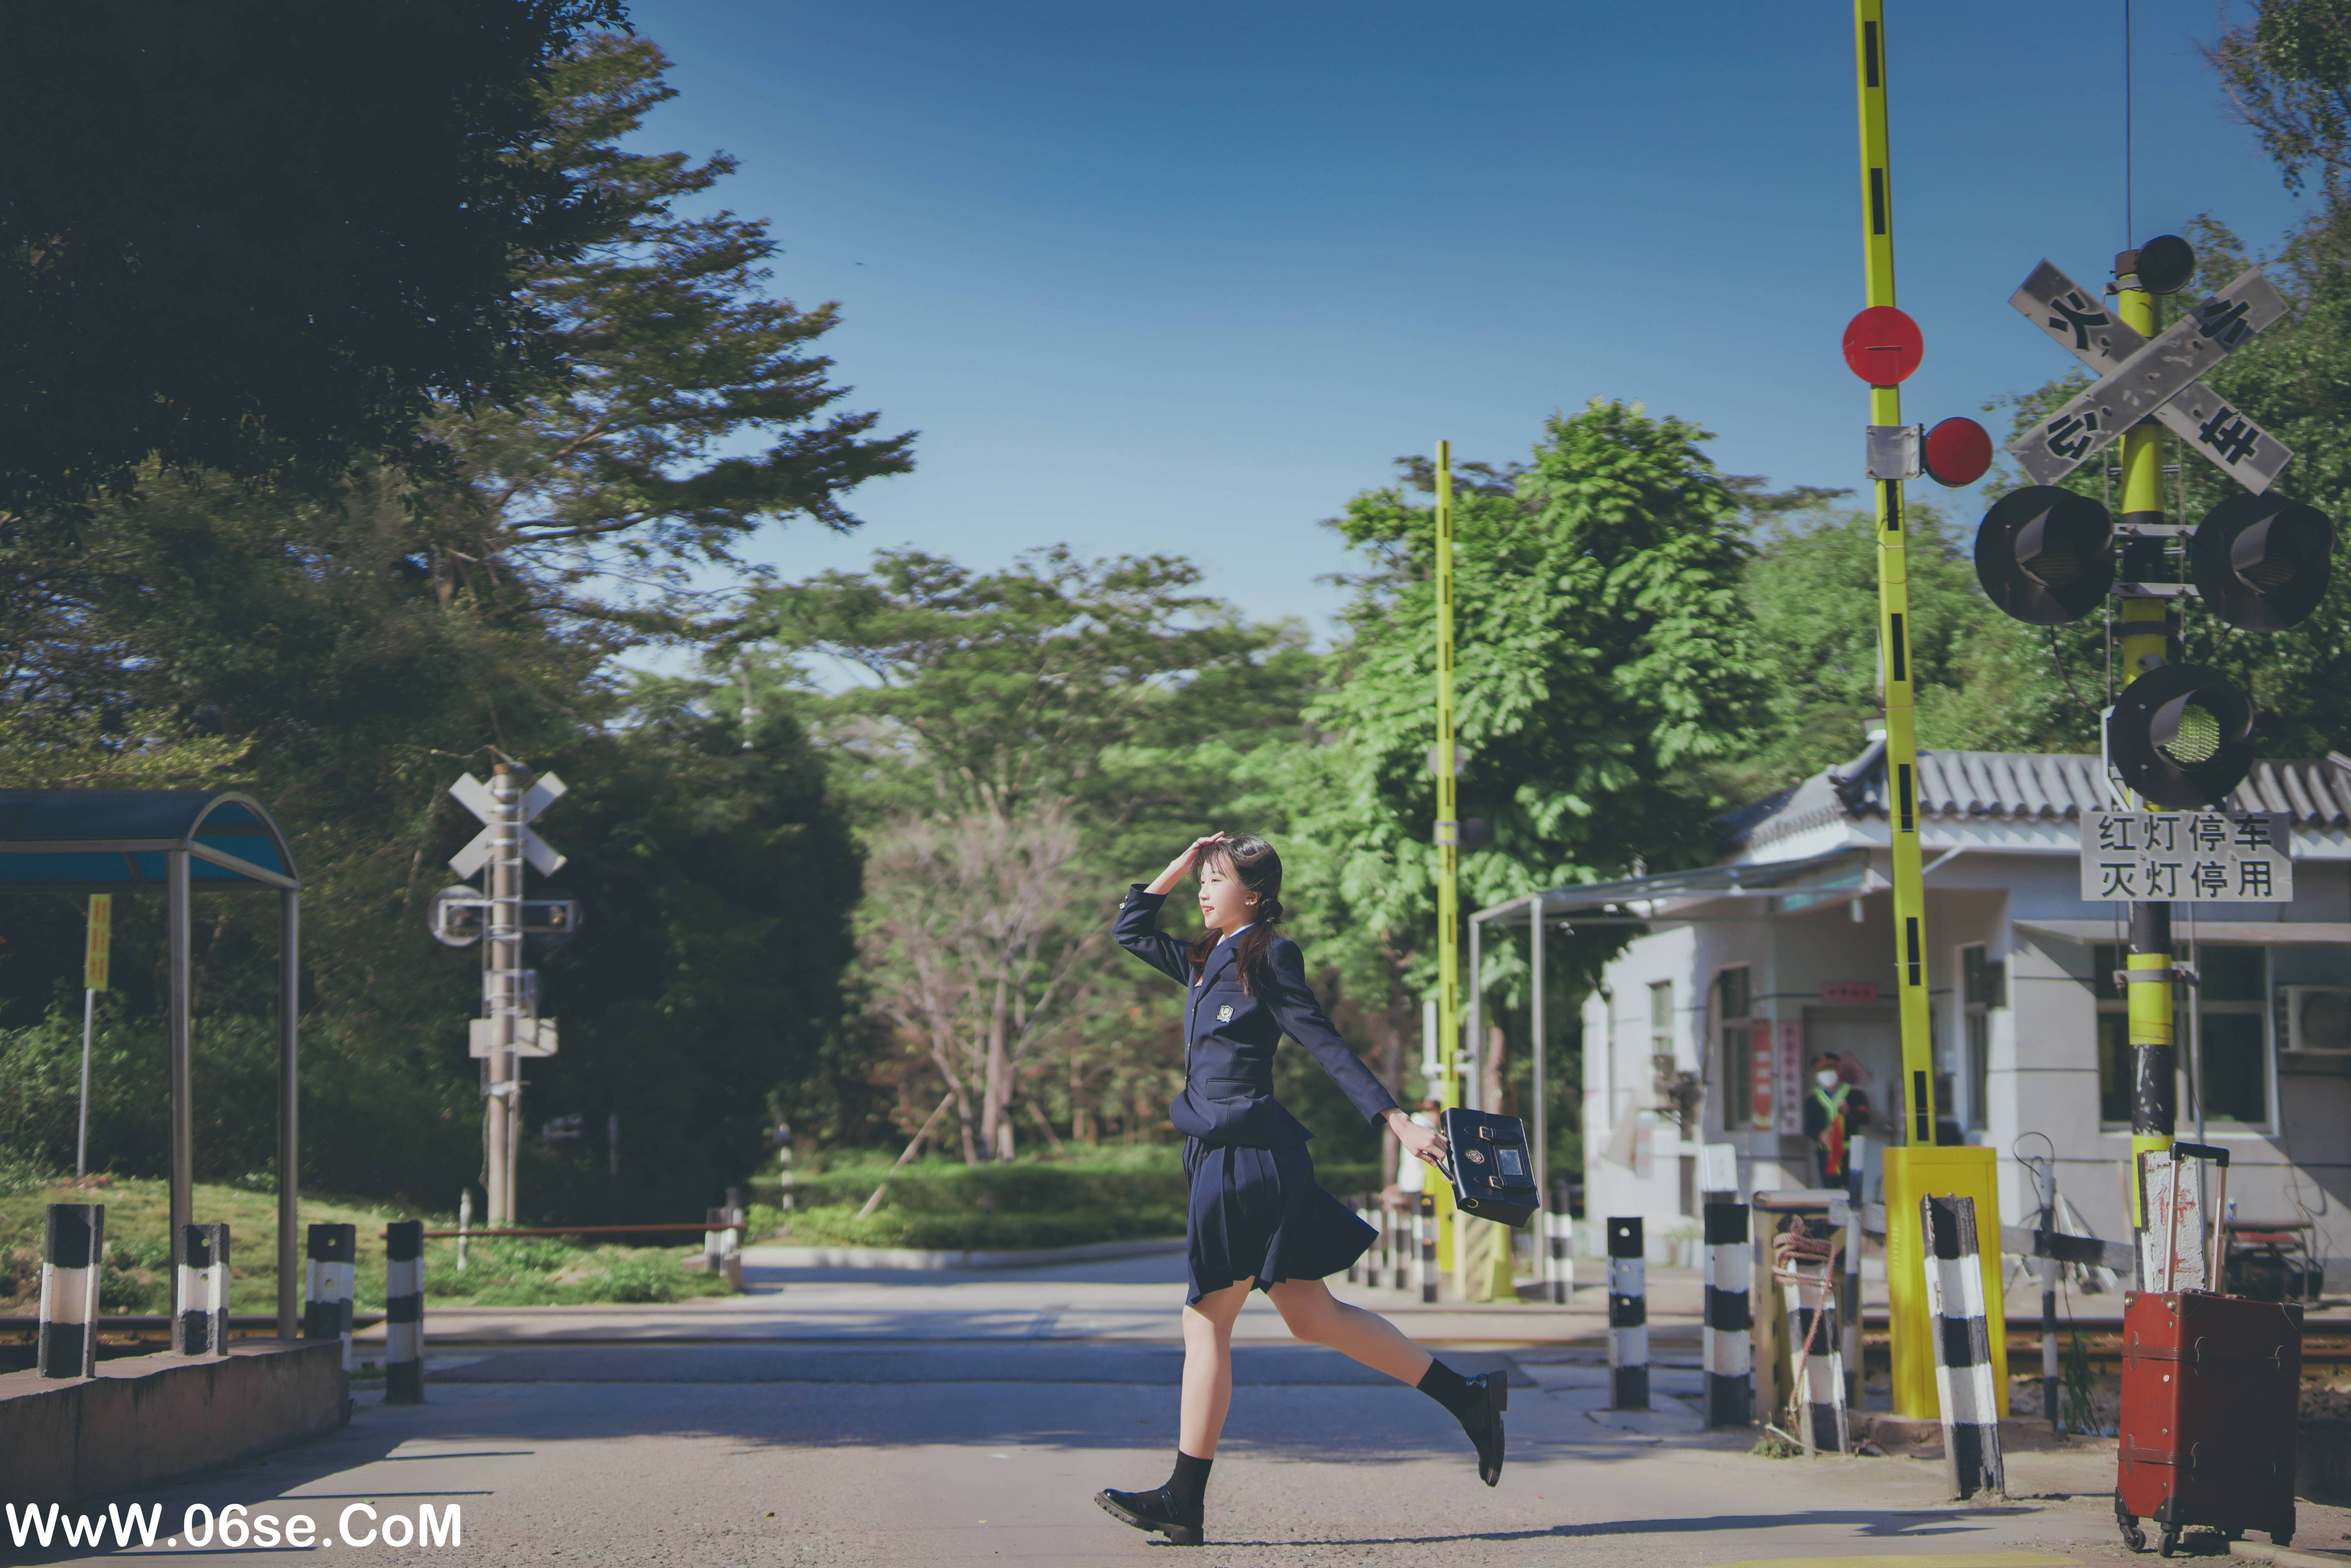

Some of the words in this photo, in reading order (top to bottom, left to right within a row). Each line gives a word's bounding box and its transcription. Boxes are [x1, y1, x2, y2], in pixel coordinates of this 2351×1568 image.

[2099, 815, 2272, 851] 红灯停车
[2101, 861, 2273, 898] 灭灯停用
